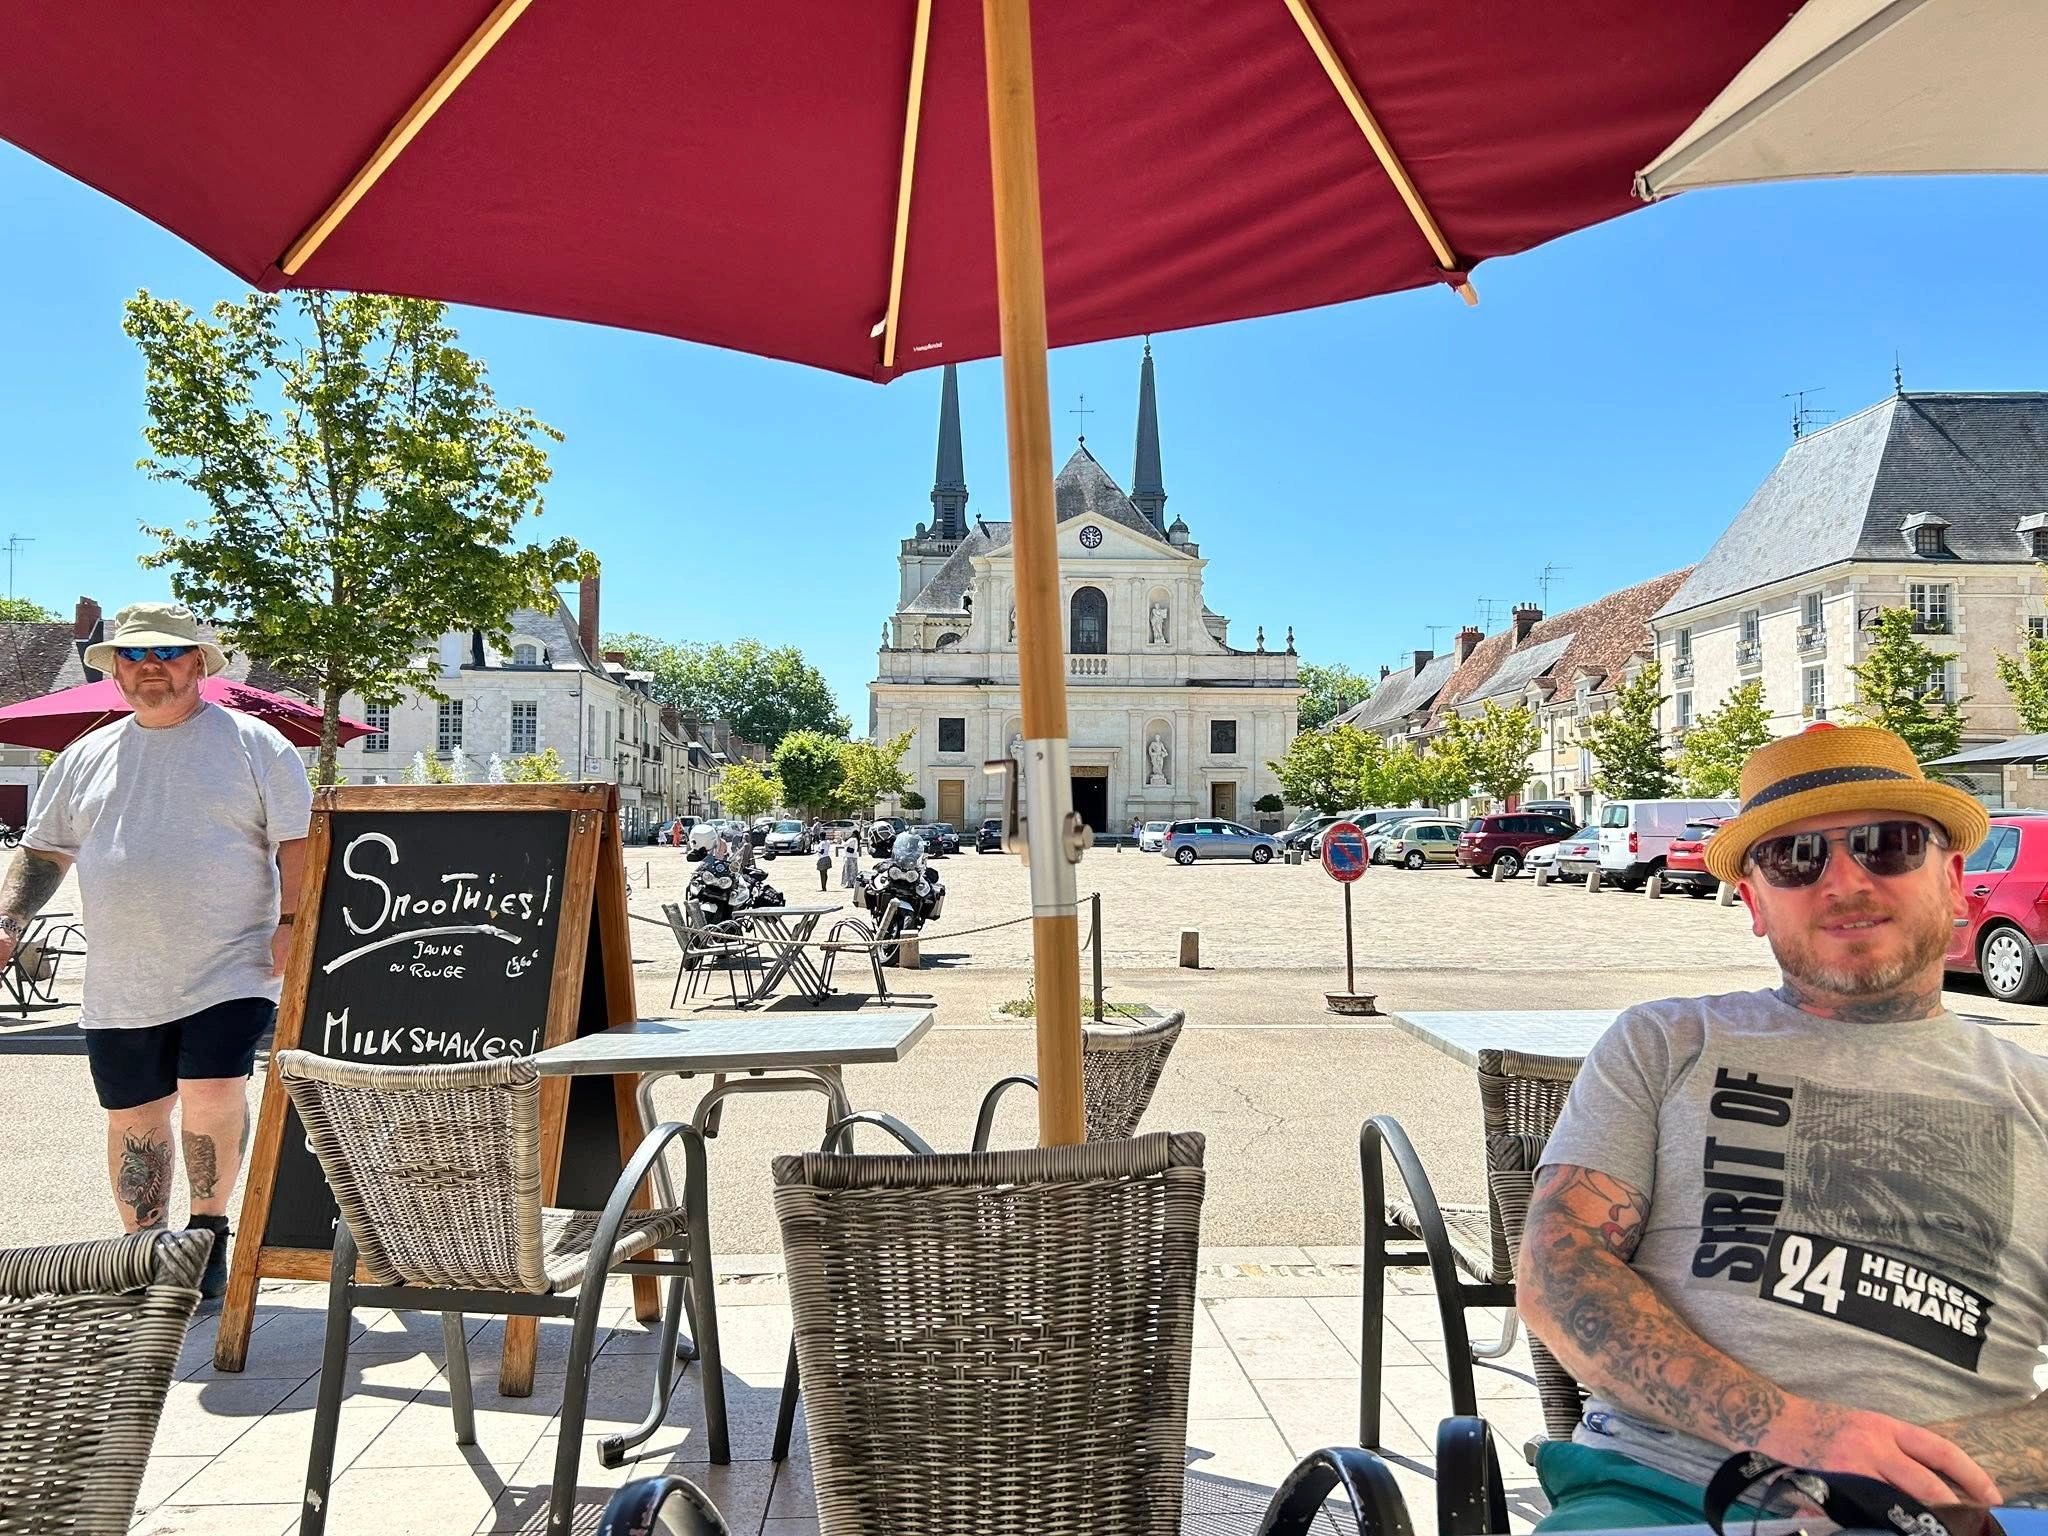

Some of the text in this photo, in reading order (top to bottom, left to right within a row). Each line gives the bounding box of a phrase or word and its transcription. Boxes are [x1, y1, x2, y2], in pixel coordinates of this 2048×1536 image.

[409, 963, 466, 979] ROUGE
[413, 941, 464, 960] JAUNE
[1710, 1067, 1794, 1127] OF
[1773, 1235, 1846, 1315] 24
[1861, 1252, 1981, 1317] HEURES
[1857, 1279, 1978, 1337] DU MANS
